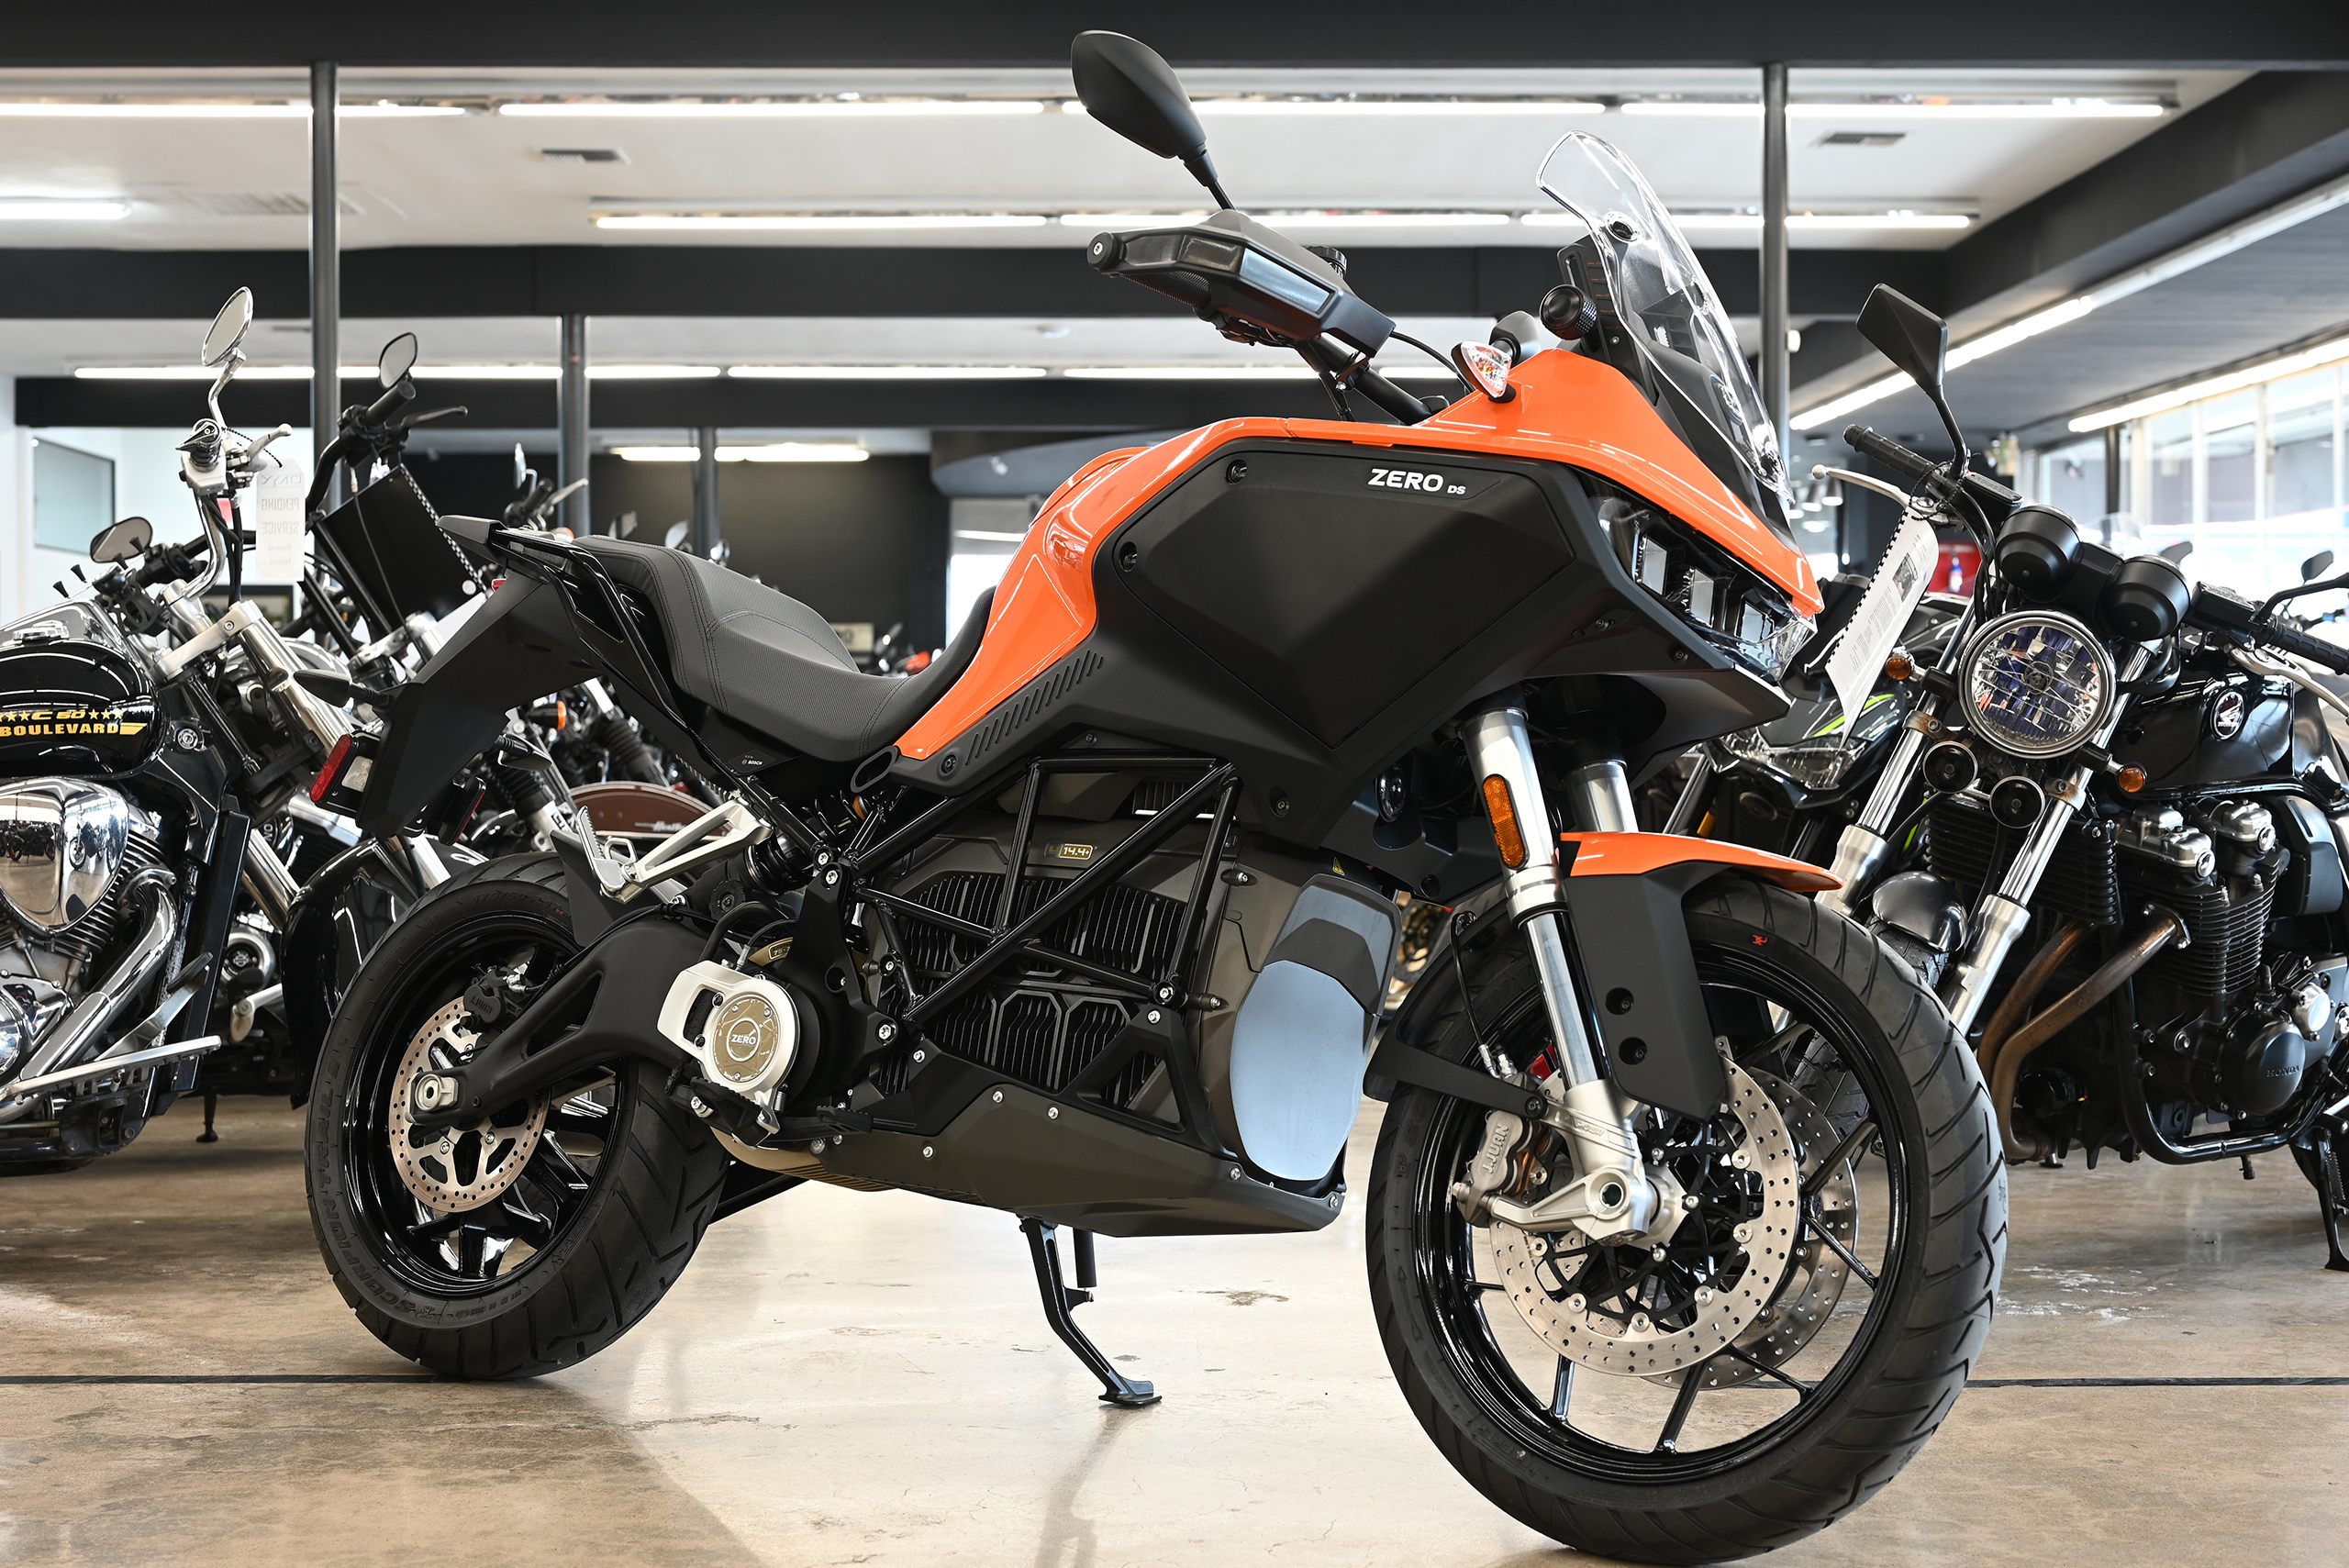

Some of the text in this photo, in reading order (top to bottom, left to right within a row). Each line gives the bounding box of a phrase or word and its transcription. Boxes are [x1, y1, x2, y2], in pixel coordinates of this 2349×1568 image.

[1367, 468, 1466, 495] ZERO DS
[0, 723, 119, 737] BOULEVARD
[1064, 847, 1090, 856] 14.4+
[731, 1034, 757, 1045] ZERO
[2266, 1065, 2300, 1077] HONDA
[1482, 1123, 1509, 1174] J.JUAN
